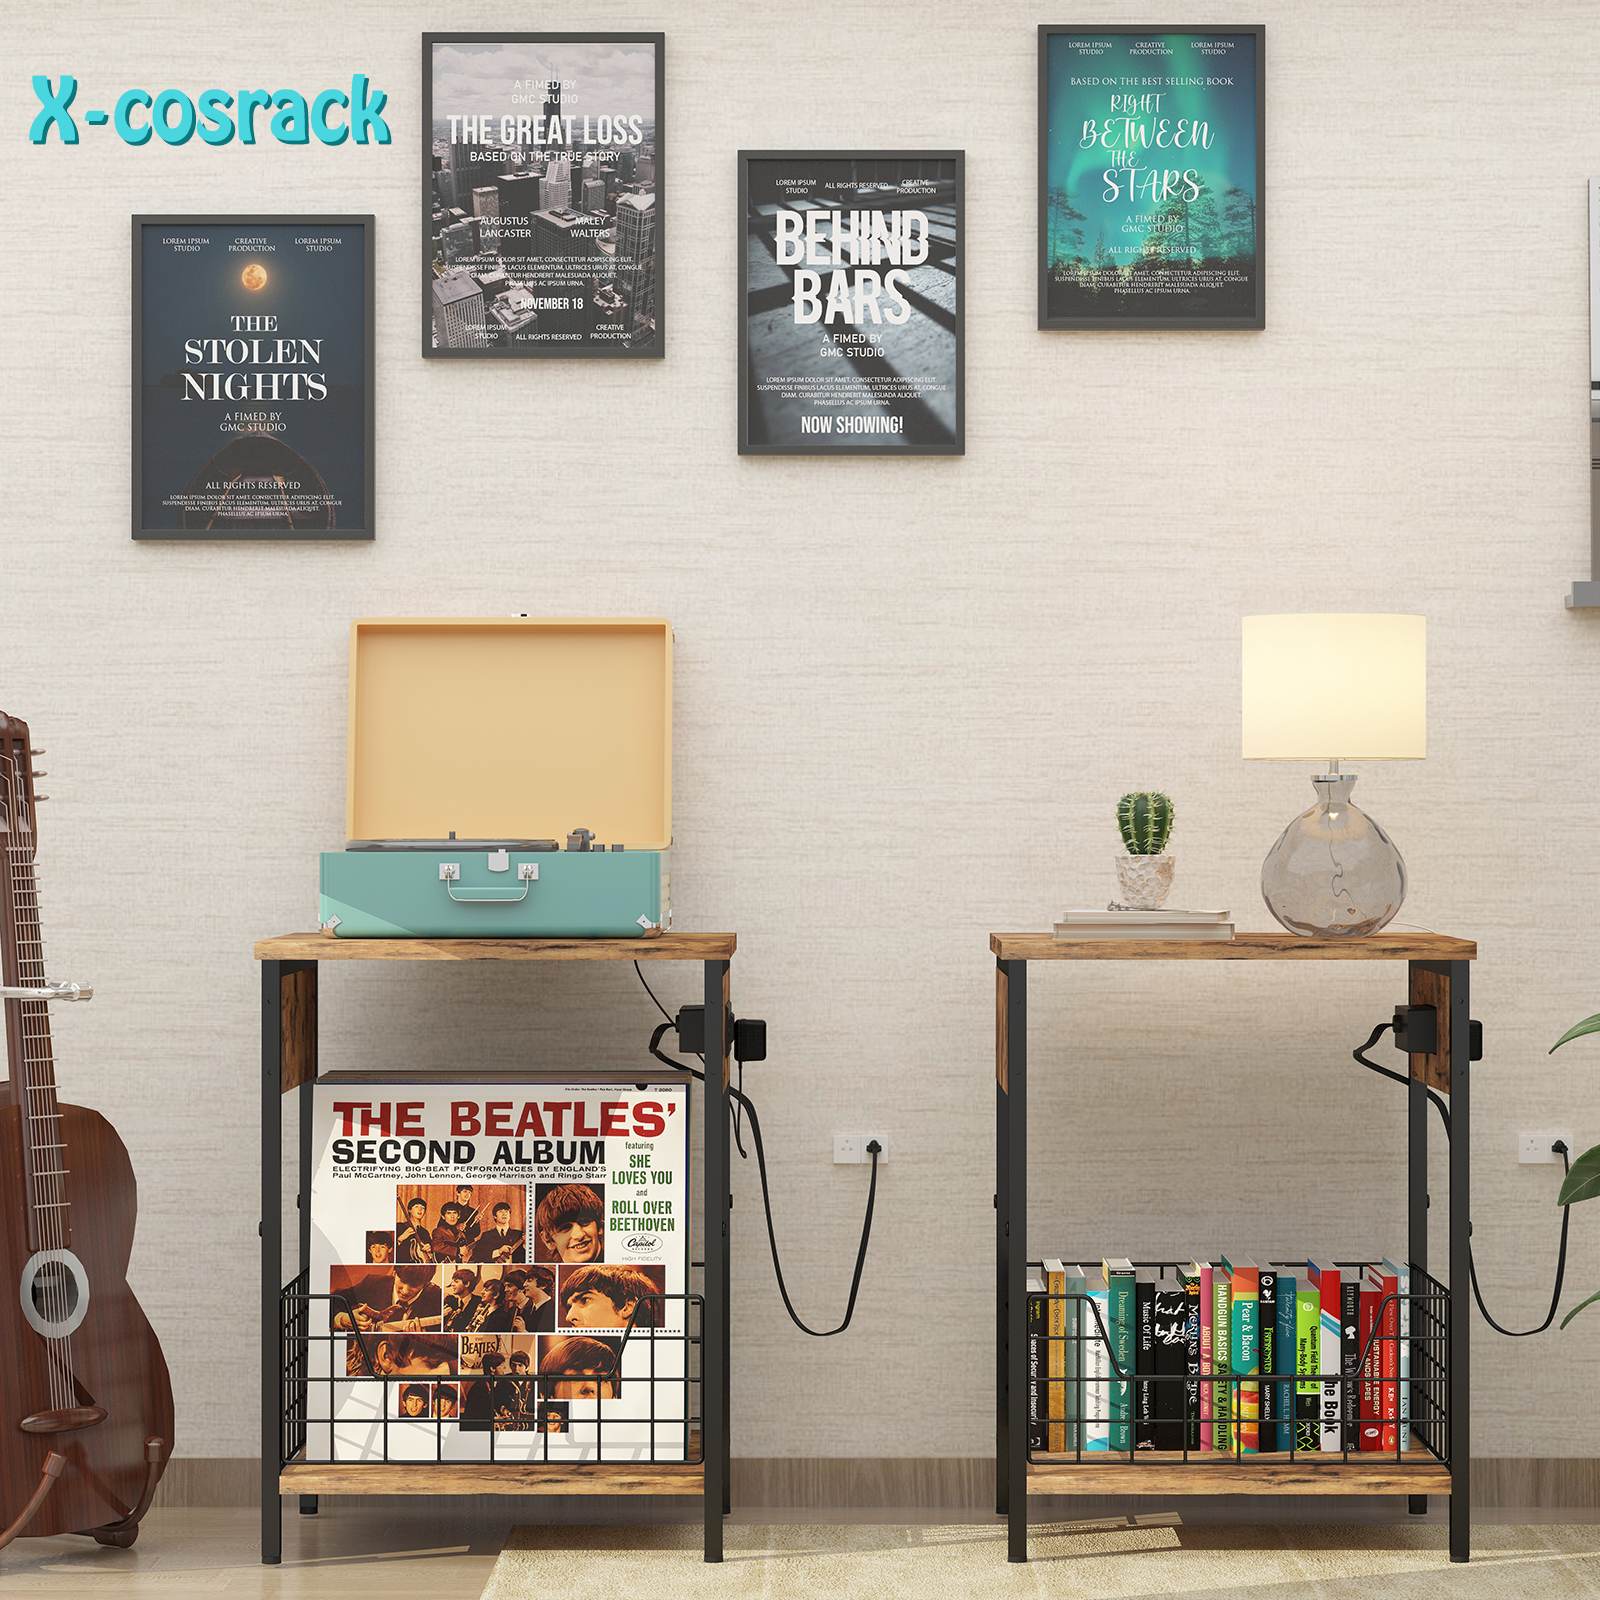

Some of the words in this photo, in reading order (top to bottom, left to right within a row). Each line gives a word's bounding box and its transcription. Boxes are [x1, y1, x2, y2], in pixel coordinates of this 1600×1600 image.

[513, 80, 522, 90] A
[525, 80, 559, 90] FIMED
[563, 80, 577, 90] BY
[1070, 77, 1100, 86] BASED
[1101, 77, 1117, 86] ON
[1120, 77, 1139, 86] THE
[1141, 77, 1163, 86] BEST
[1165, 77, 1204, 86] SELLING
[1206, 77, 1234, 86] BOOK
[511, 94, 536, 104] GMC
[539, 94, 579, 104] STUDIO
[1110, 92, 1167, 116] RIGHT
[446, 114, 493, 145] THE
[500, 114, 576, 145] GREAT
[583, 114, 643, 145] LOSS
[1078, 115, 1216, 150] BETWEEN
[470, 152, 507, 162] BASED
[510, 152, 526, 162] ON
[529, 152, 550, 162] THE
[554, 152, 583, 162] TRUE
[586, 152, 621, 162] STORY
[1106, 149, 1140, 169] THE
[1102, 166, 1205, 204] STARS
[480, 216, 529, 226] AUGUSTUS
[575, 216, 606, 226] MALEY
[1125, 215, 1133, 223] A
[1135, 215, 1165, 223] FIMED
[1167, 215, 1179, 223] BY
[479, 229, 531, 238] LANCASTER
[570, 229, 610, 238] WALTERS
[1121, 224, 1145, 233] GMC
[1147, 224, 1184, 233] STUDIO
[773, 210, 929, 266] BEHIND
[1108, 246, 1123, 254] ALL
[1156, 246, 1197, 254] RESERVED
[520, 297, 570, 310] NOVEMBER
[572, 297, 584, 310] 18
[790, 268, 912, 325] BARS
[230, 315, 278, 332] THE
[822, 333, 830, 343] A
[833, 333, 866, 343] FIMED
[869, 333, 883, 343] BY
[184, 338, 324, 365] STOLEN
[820, 347, 844, 357] GMC
[846, 347, 885, 357] STUDIO
[180, 372, 328, 401] NIGHTS
[224, 412, 232, 421] A
[234, 412, 267, 421] FIMED
[270, 412, 282, 421] BY
[219, 422, 245, 432] GMC
[247, 422, 287, 432] STUDIO
[801, 415, 833, 434] NOW
[836, 415, 903, 434] SHOWING!
[205, 481, 221, 490] ALL
[223, 481, 256, 490] RIGHTS
[258, 481, 301, 490] RESERVED
[332, 1101, 426, 1138] THE
[450, 1101, 677, 1138] BEATLES'
[332, 1139, 476, 1165] SECOND
[492, 1139, 606, 1165] ALBUM
[625, 1141, 654, 1151] featuring
[629, 1154, 651, 1168] SHE
[354, 1172, 403, 1180] McCartney,
[429, 1172, 464, 1180] Lennon,
[465, 1172, 497, 1180] George
[557, 1172, 583, 1180] Ringo
[612, 1170, 647, 1185] LOVES
[650, 1170, 673, 1185] YOU
[635, 1188, 648, 1196] and
[612, 1200, 639, 1215] ROLL
[643, 1200, 672, 1215] OVER
[609, 1217, 675, 1232] BEETHOVEN
[627, 1238, 657, 1248] Capitol
[1115, 1291, 1129, 1325] Dreaming
[1217, 1284, 1227, 1327] HANDGUN
[1346, 1285, 1354, 1316] KEYWORTH
[1142, 1301, 1151, 1324] Music
[1242, 1302, 1254, 1322] Pear
[1118, 1326, 1129, 1334] of
[1142, 1324, 1151, 1335] Of
[1242, 1324, 1254, 1332] &
[1142, 1336, 1151, 1351] Life
[1202, 1326, 1211, 1350] ABOUT
[1310, 1325, 1318, 1350] Quantum
[461, 1336, 496, 1358] BEATLES
[1118, 1334, 1129, 1362] Sweden
[1217, 1330, 1227, 1361] BASICS
[1242, 1334, 1254, 1361] Bacon
[1298, 1338, 1307, 1368] Many-Body
[1310, 1351, 1318, 1364] Field
[1344, 1353, 1356, 1366] The
[1202, 1362, 1211, 1376] BOY
[1217, 1363, 1227, 1395] SAETY
[1324, 1373, 1339, 1396] he
[1030, 1385, 1038, 1396] and
[1217, 1396, 1227, 1404] &
[1119, 1402, 1128, 1424] Andre
[1119, 1425, 1128, 1444] Brown
[1217, 1406, 1227, 1450] HADLING
